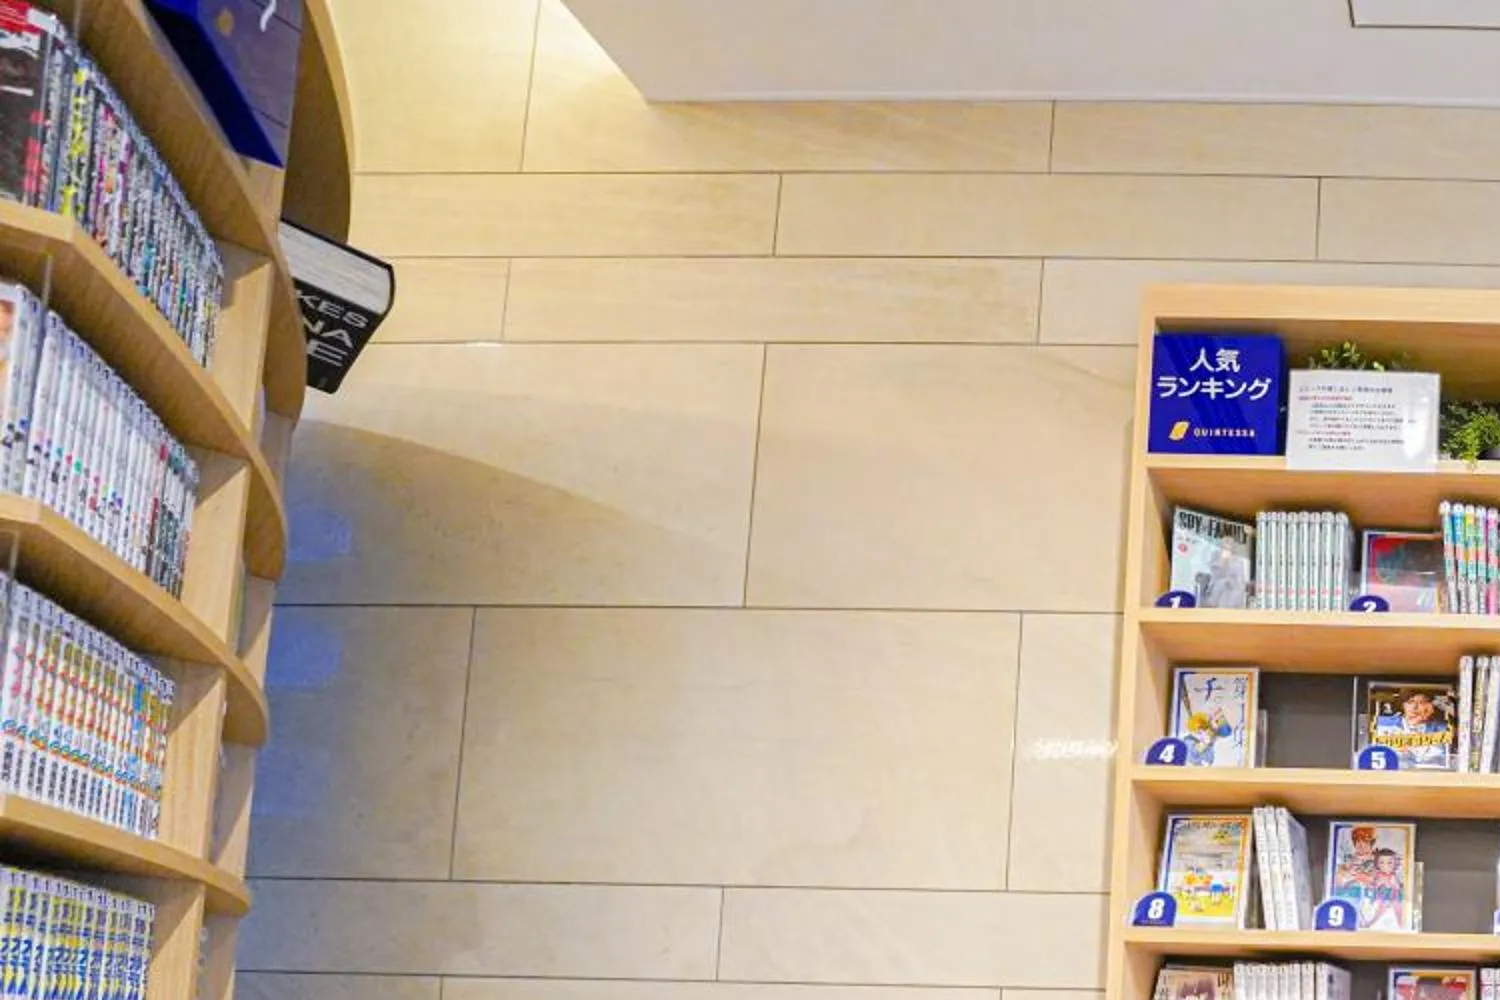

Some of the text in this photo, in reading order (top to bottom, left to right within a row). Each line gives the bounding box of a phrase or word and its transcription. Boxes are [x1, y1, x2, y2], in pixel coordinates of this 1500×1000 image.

[1189, 347, 1241, 373] 人気
[1156, 376, 1273, 401] ランキング
[1158, 743, 1175, 763] 4
[1371, 751, 1386, 769] 5
[1148, 899, 1165, 919] 8
[1328, 905, 1344, 927] 9
